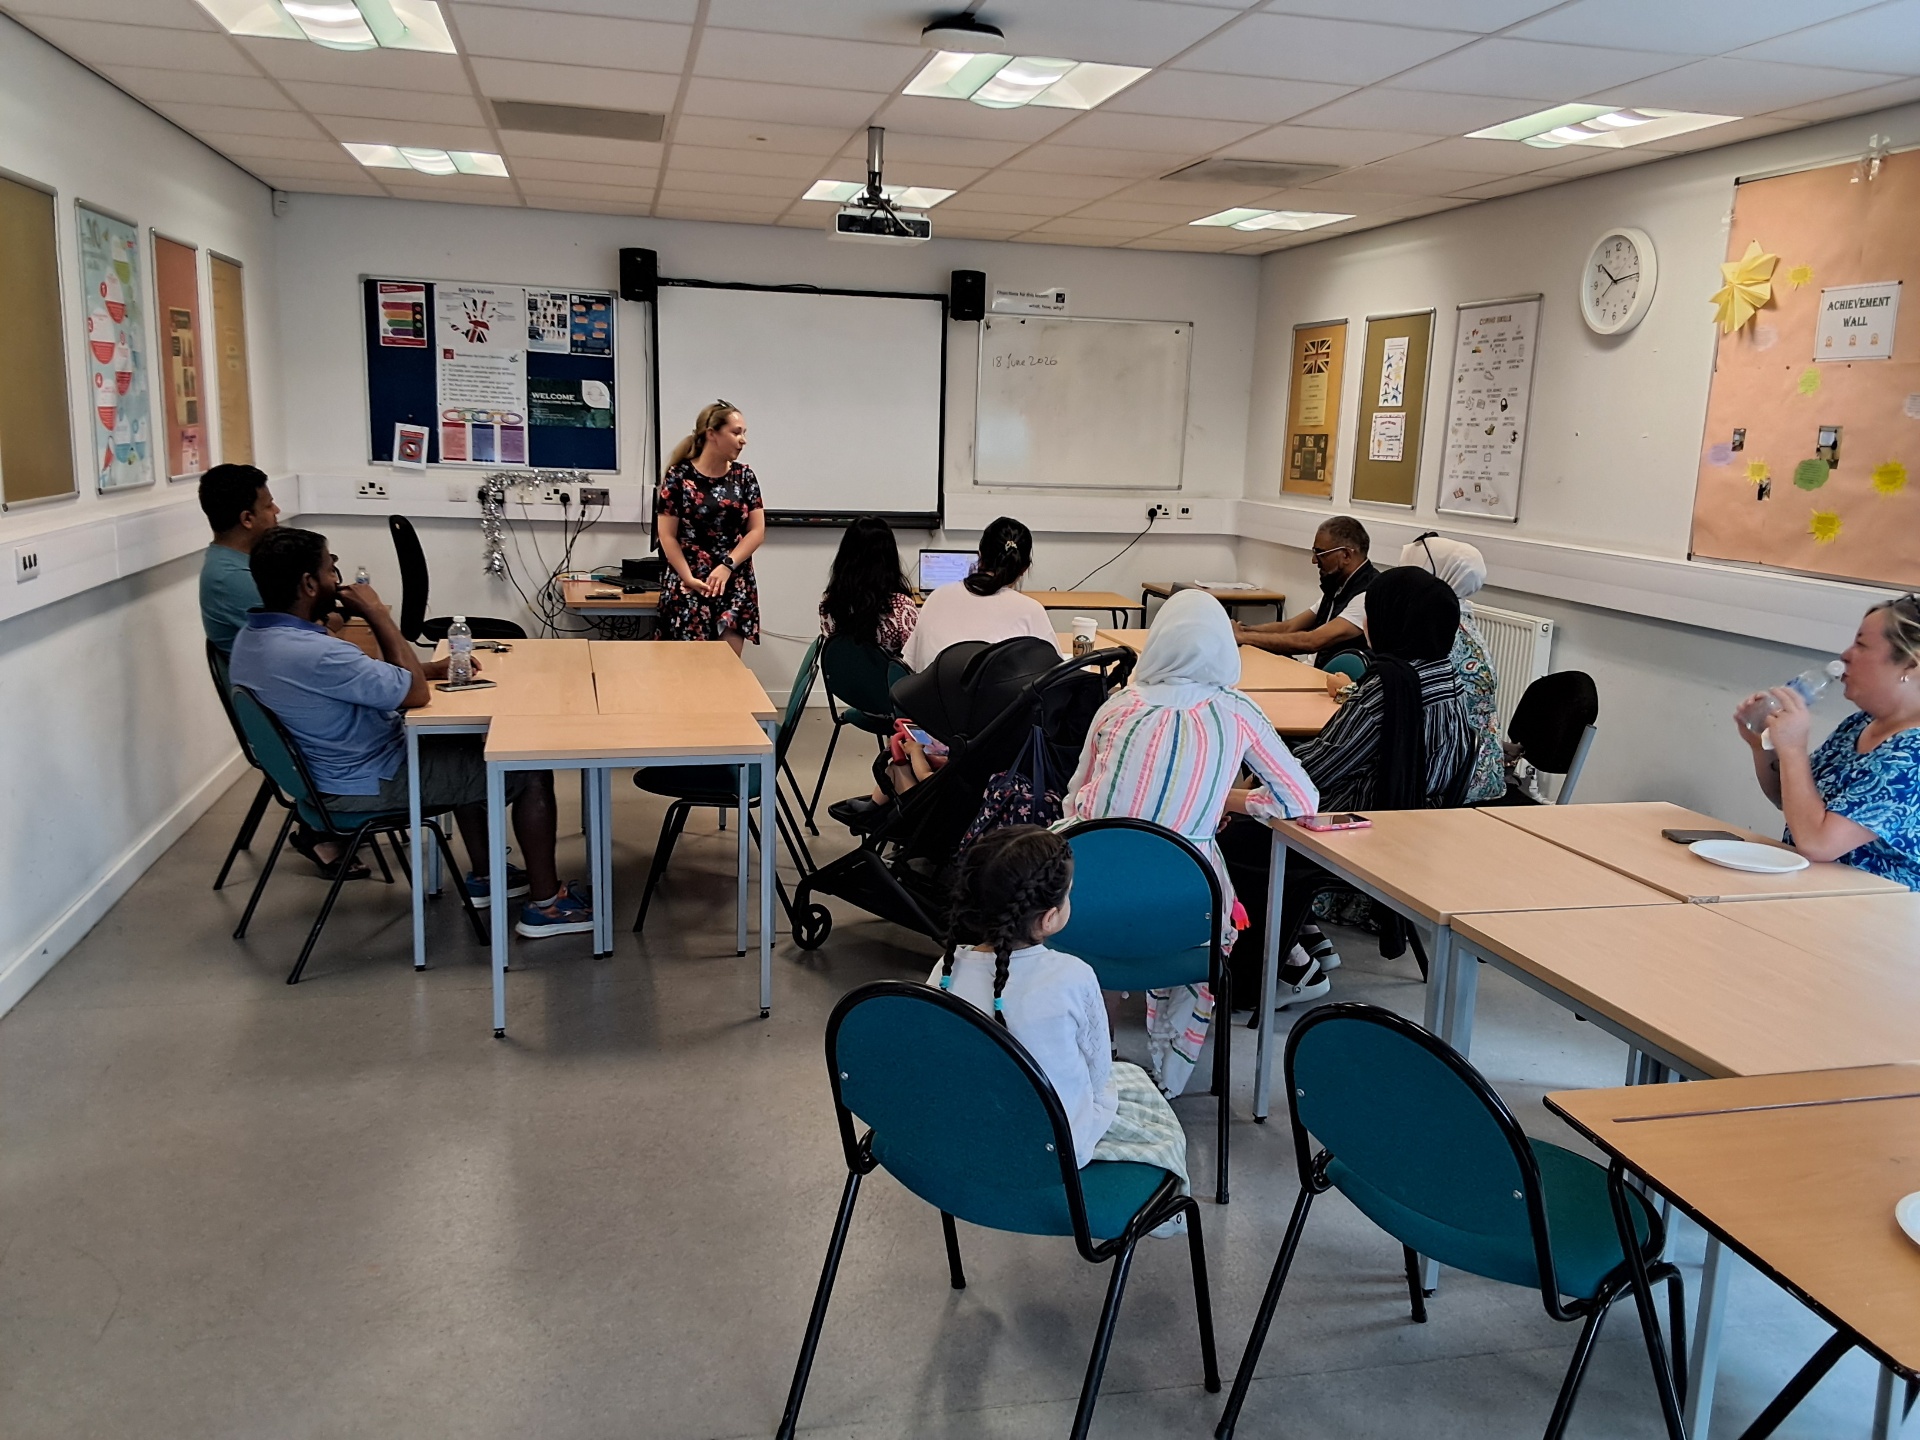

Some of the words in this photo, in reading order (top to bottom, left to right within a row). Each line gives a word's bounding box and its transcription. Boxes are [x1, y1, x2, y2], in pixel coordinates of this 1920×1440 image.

[1615, 242, 1622, 252] 12
[1627, 244, 1631, 254] 1
[1605, 250, 1611, 259] 11
[1633, 255, 1639, 266] 2
[1597, 264, 1603, 273] 10
[1593, 281, 1599, 291] 9
[1631, 291, 1636, 299] 4
[1595, 297, 1600, 307] 8
[1827, 296, 1891, 311] ACHIEVEMENT
[1602, 308, 1607, 318] 7
[1622, 304, 1628, 315] 5
[1611, 311, 1617, 321] 6
[1843, 316, 1868, 328] WALL
[992, 355, 1003, 368] 18
[1028, 355, 1058, 367] 2026
[531, 392, 575, 401] WELCOME
